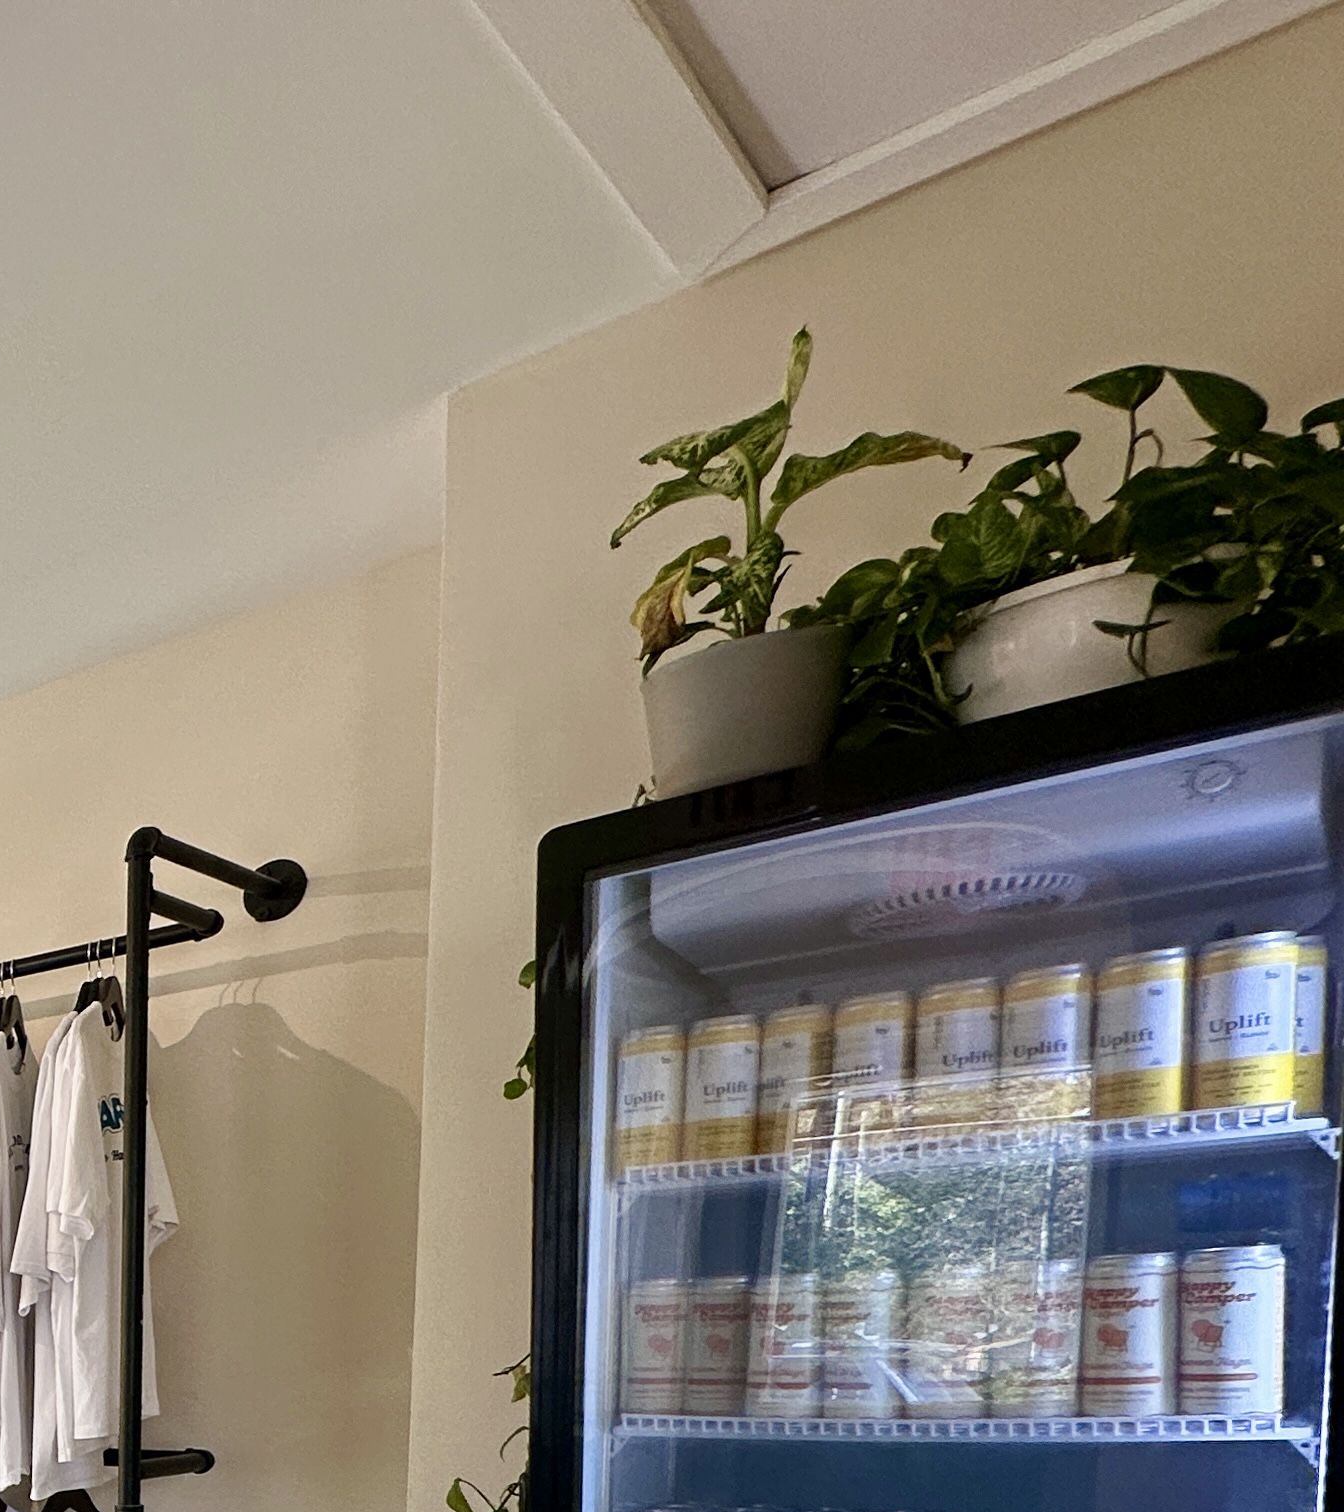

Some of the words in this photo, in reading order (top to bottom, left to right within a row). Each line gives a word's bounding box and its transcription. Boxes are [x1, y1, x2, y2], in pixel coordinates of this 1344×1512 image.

[1209, 1012, 1271, 1035] Uplift
[1100, 1028, 1155, 1049] Uplift
[1013, 1040, 1069, 1060] Uplift
[703, 1081, 750, 1098] Uplift
[757, 1076, 786, 1092] plift
[623, 1090, 665, 1107] Uplift
